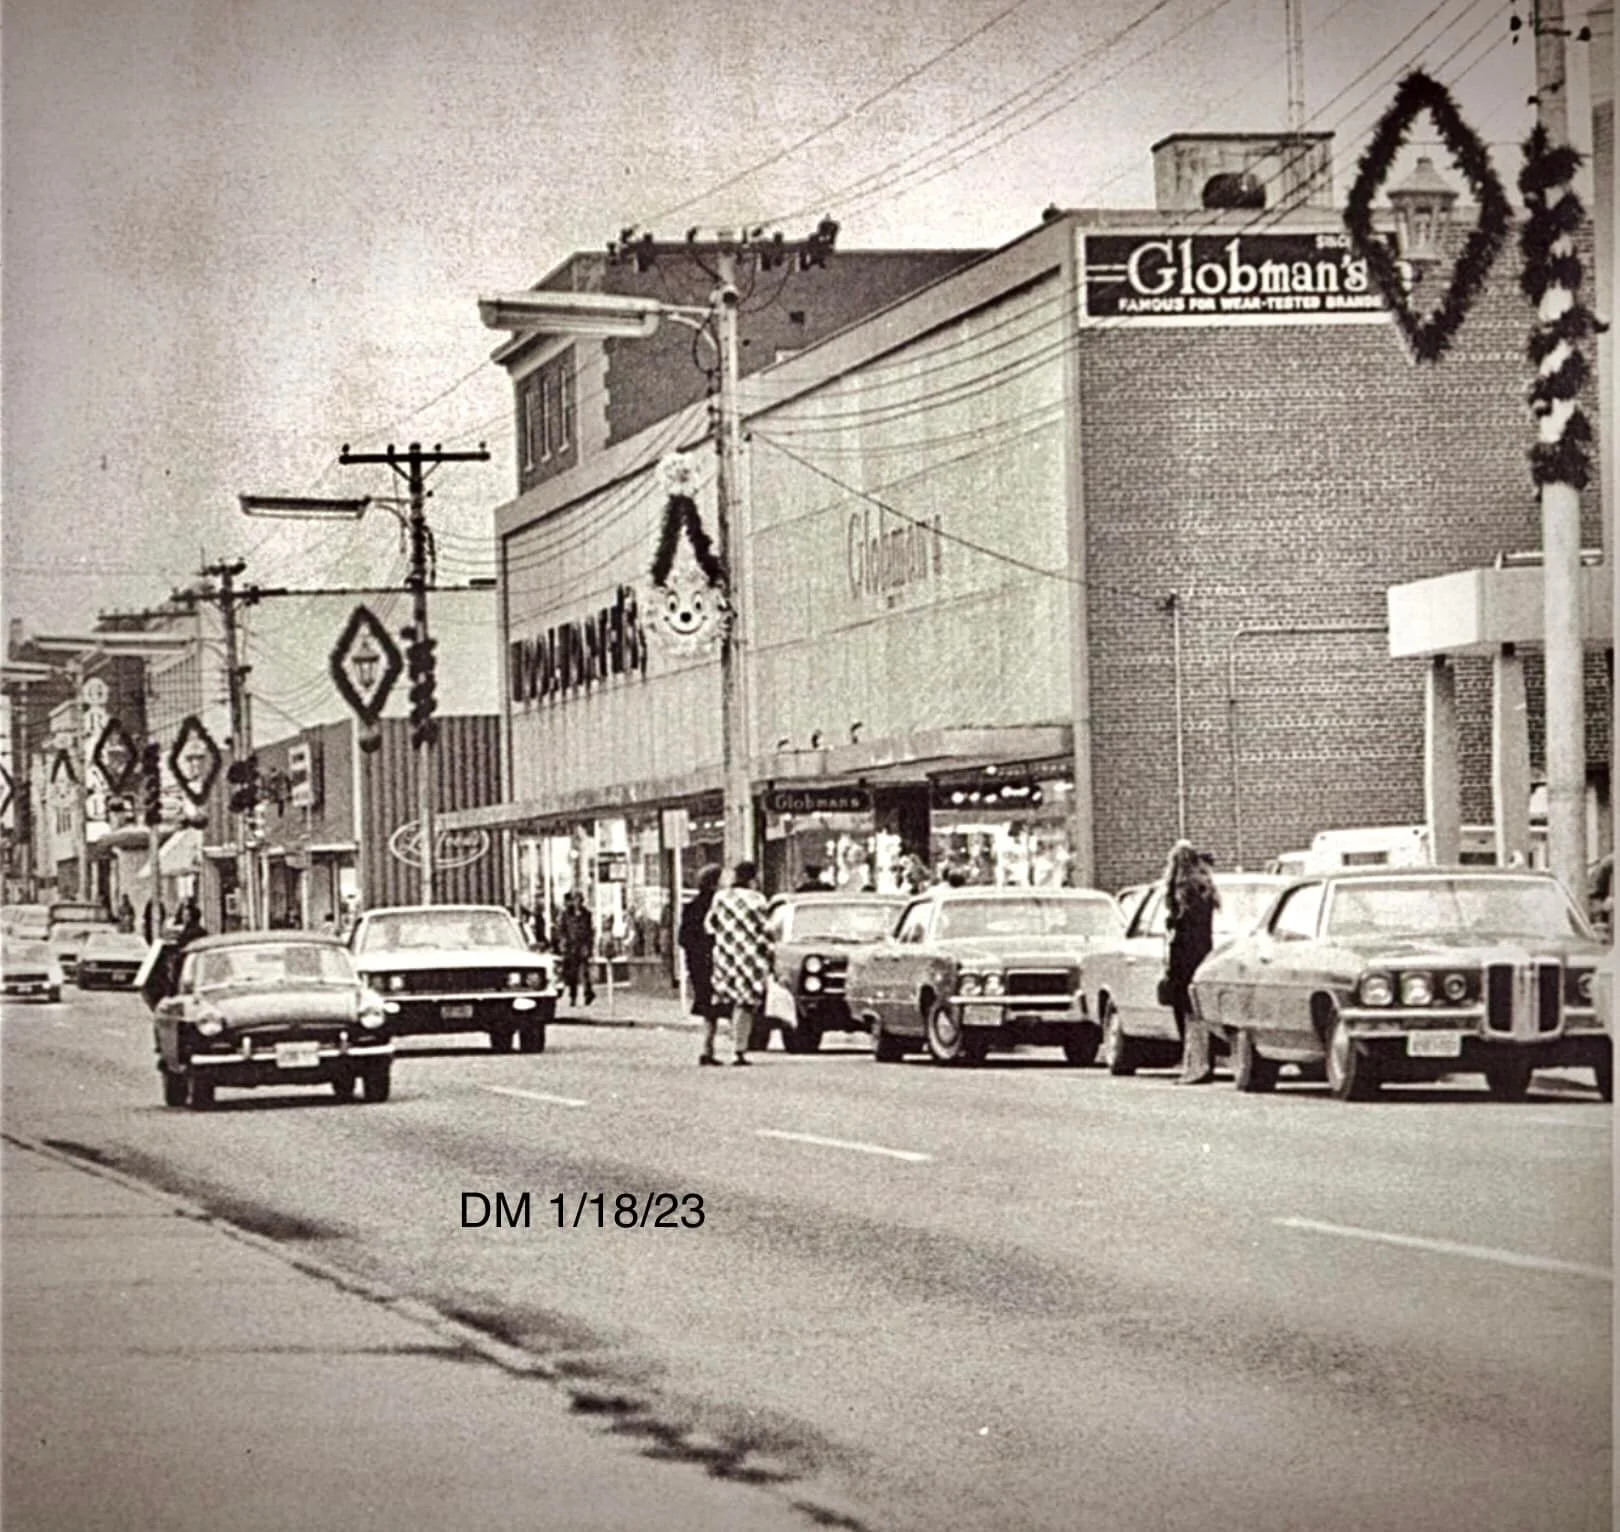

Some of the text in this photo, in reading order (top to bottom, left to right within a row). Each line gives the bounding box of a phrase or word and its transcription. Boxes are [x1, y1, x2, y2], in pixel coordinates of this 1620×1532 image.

[1127, 238, 1368, 295] Globman's
[1118, 297, 1185, 312] FAMOUS
[1189, 297, 1216, 311] FOR
[1219, 295, 1320, 311] WEAR-TESTED
